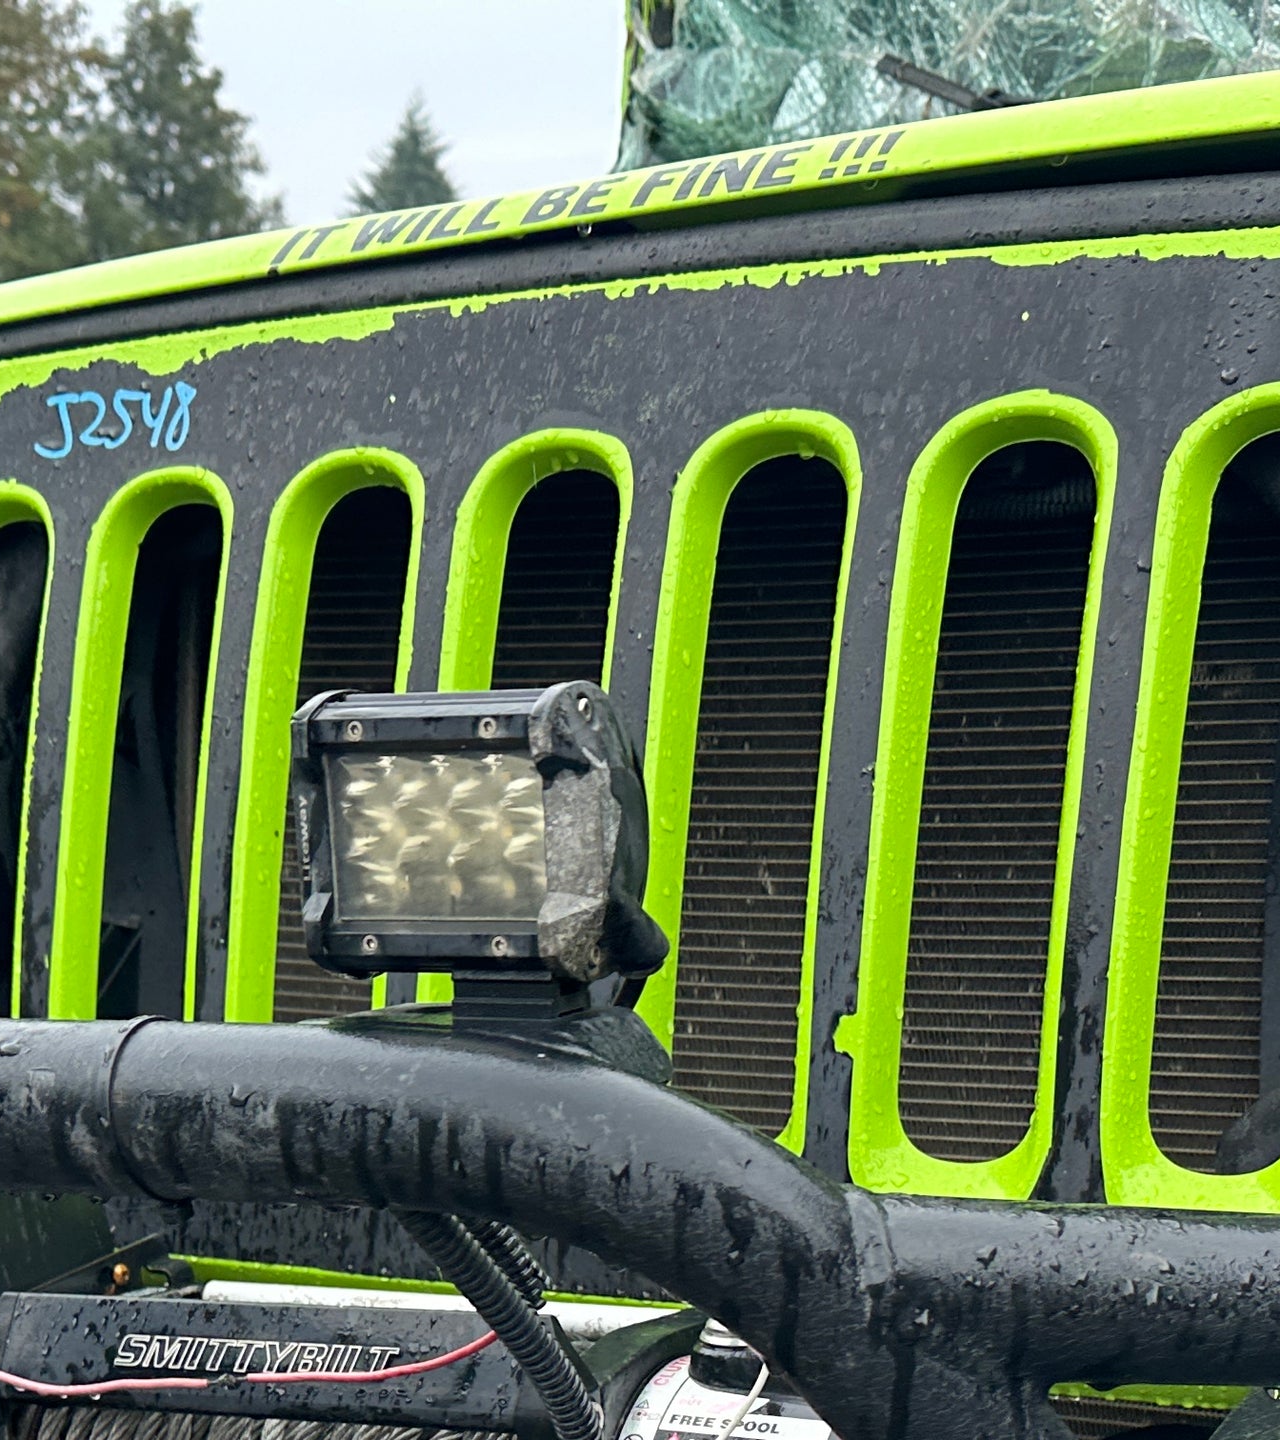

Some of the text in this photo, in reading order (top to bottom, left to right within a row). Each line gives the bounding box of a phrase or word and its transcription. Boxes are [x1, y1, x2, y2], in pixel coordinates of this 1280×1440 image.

[270, 130, 906, 266] IT WILL BE FINE !!!
[33, 380, 197, 459] J2548
[114, 1333, 400, 1375] SMITTYBILT
[652, 1354, 690, 1386] CLUT
[668, 1413, 717, 1429] FREE
